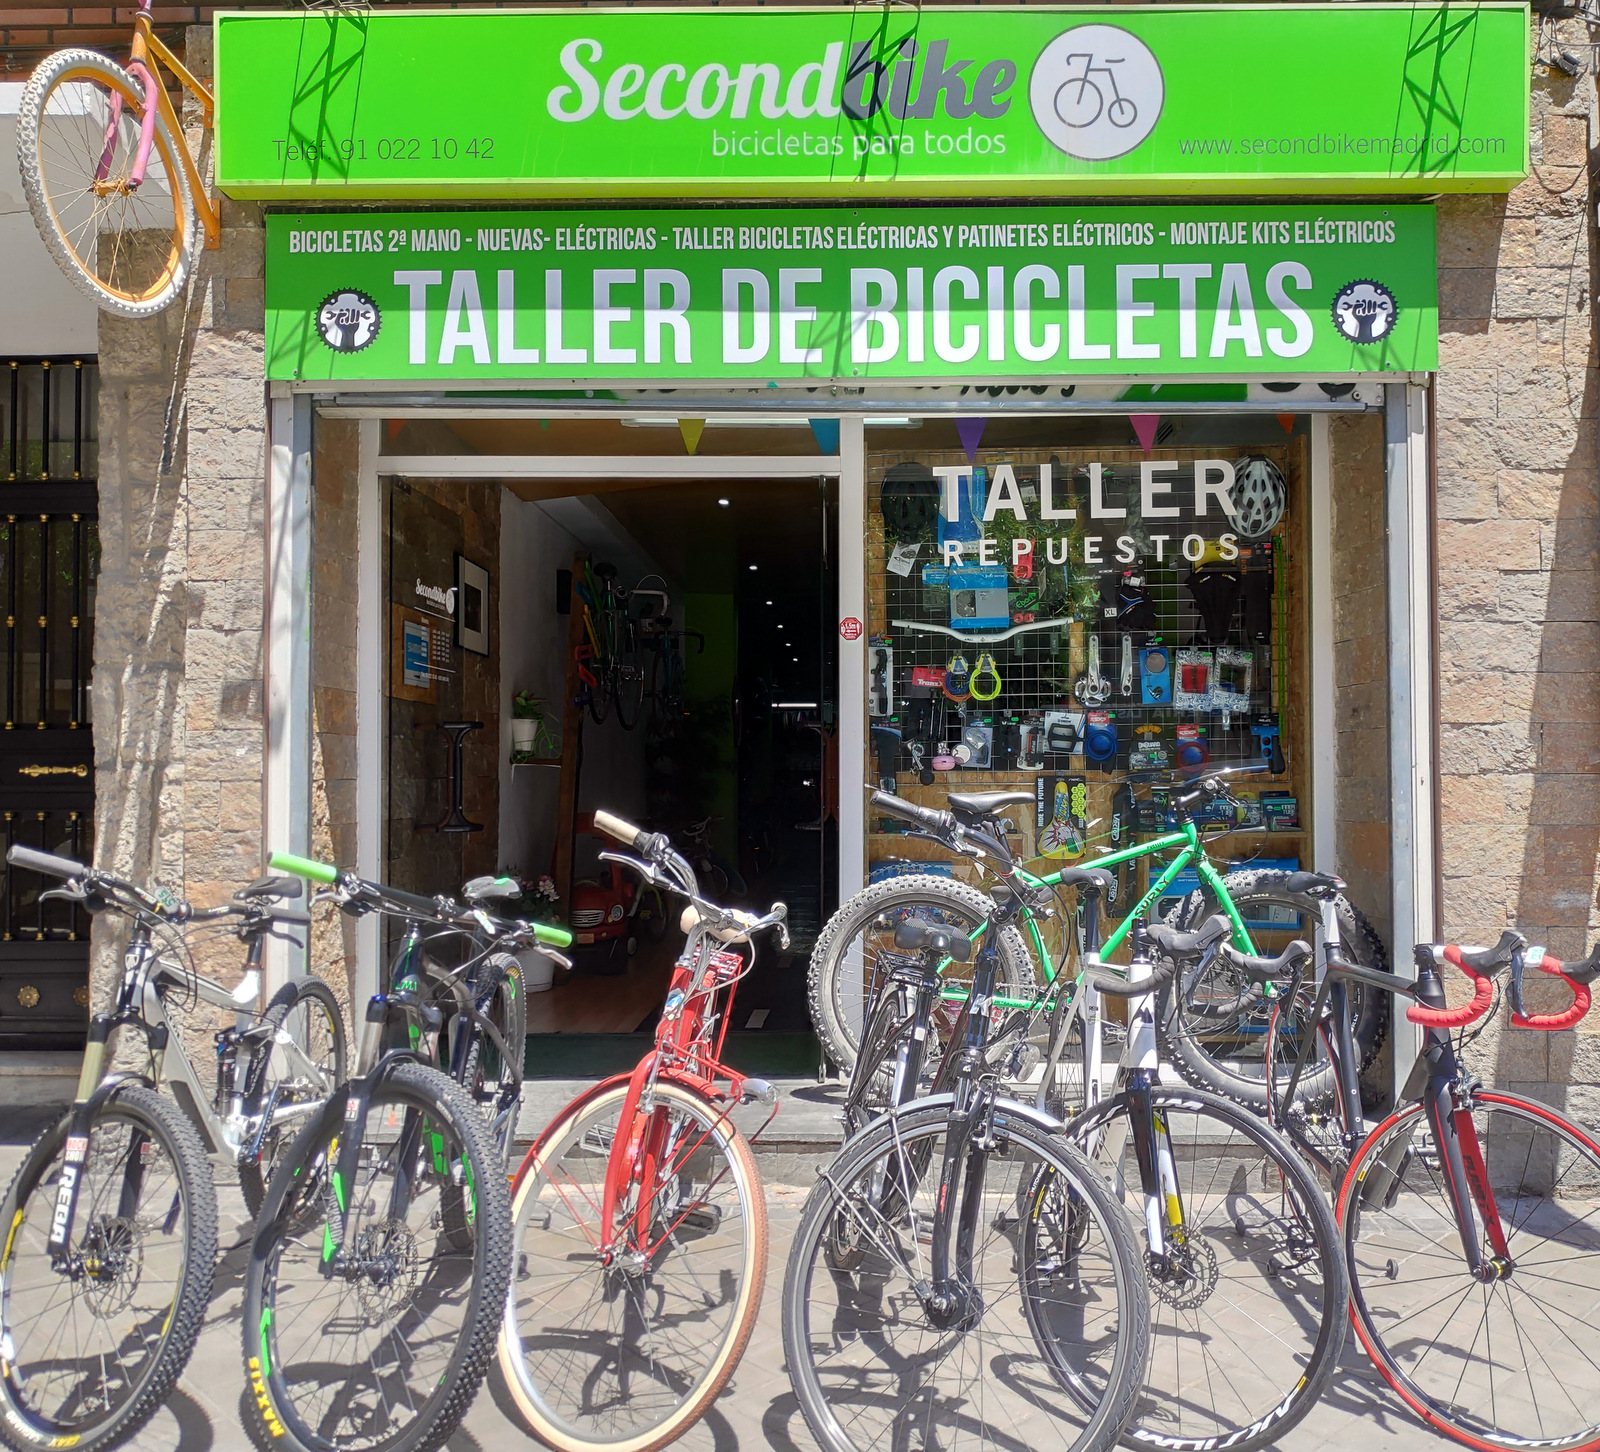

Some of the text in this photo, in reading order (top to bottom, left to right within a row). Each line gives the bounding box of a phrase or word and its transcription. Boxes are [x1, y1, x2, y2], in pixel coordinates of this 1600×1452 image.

[547, 38, 1017, 123] Secondbike
[271, 137, 495, 161] Teléf. 91 022 10 42
[712, 127, 1006, 161] bicicletas para todos
[1178, 133, 1507, 156] www.secondbikemadrid.com
[289, 230, 384, 253] BICICLETAS
[388, 229, 407, 252] 2ª
[411, 228, 461, 252] MANO
[555, 223, 657, 251] ELÉCTRICAS
[672, 227, 735, 250] TALLER
[739, 226, 834, 250] BICICLETAS
[837, 222, 939, 250] ELÉCTRICAS
[942, 225, 954, 248] Y
[958, 223, 1049, 248] PATINETES
[1052, 219, 1154, 247] ELÉCTRICOS
[1170, 221, 1248, 245] MONTAJE
[1252, 220, 1290, 244] KITS
[1294, 217, 1396, 244] ELÉCTRICOS
[393, 260, 1314, 365] TALLER DE BICICLETAS
[932, 459, 1238, 523] TALLER
[942, 532, 1241, 568] REPUESTOS
[415, 577, 446, 605] Secondbike
[1105, 608, 1116, 617] XL
[1037, 777, 1045, 827] RIDE THE FUTURE
[1133, 875, 1170, 918] SURLY
[50, 1164, 78, 1244] REBA
[248, 1356, 287, 1438] MAXXIS
